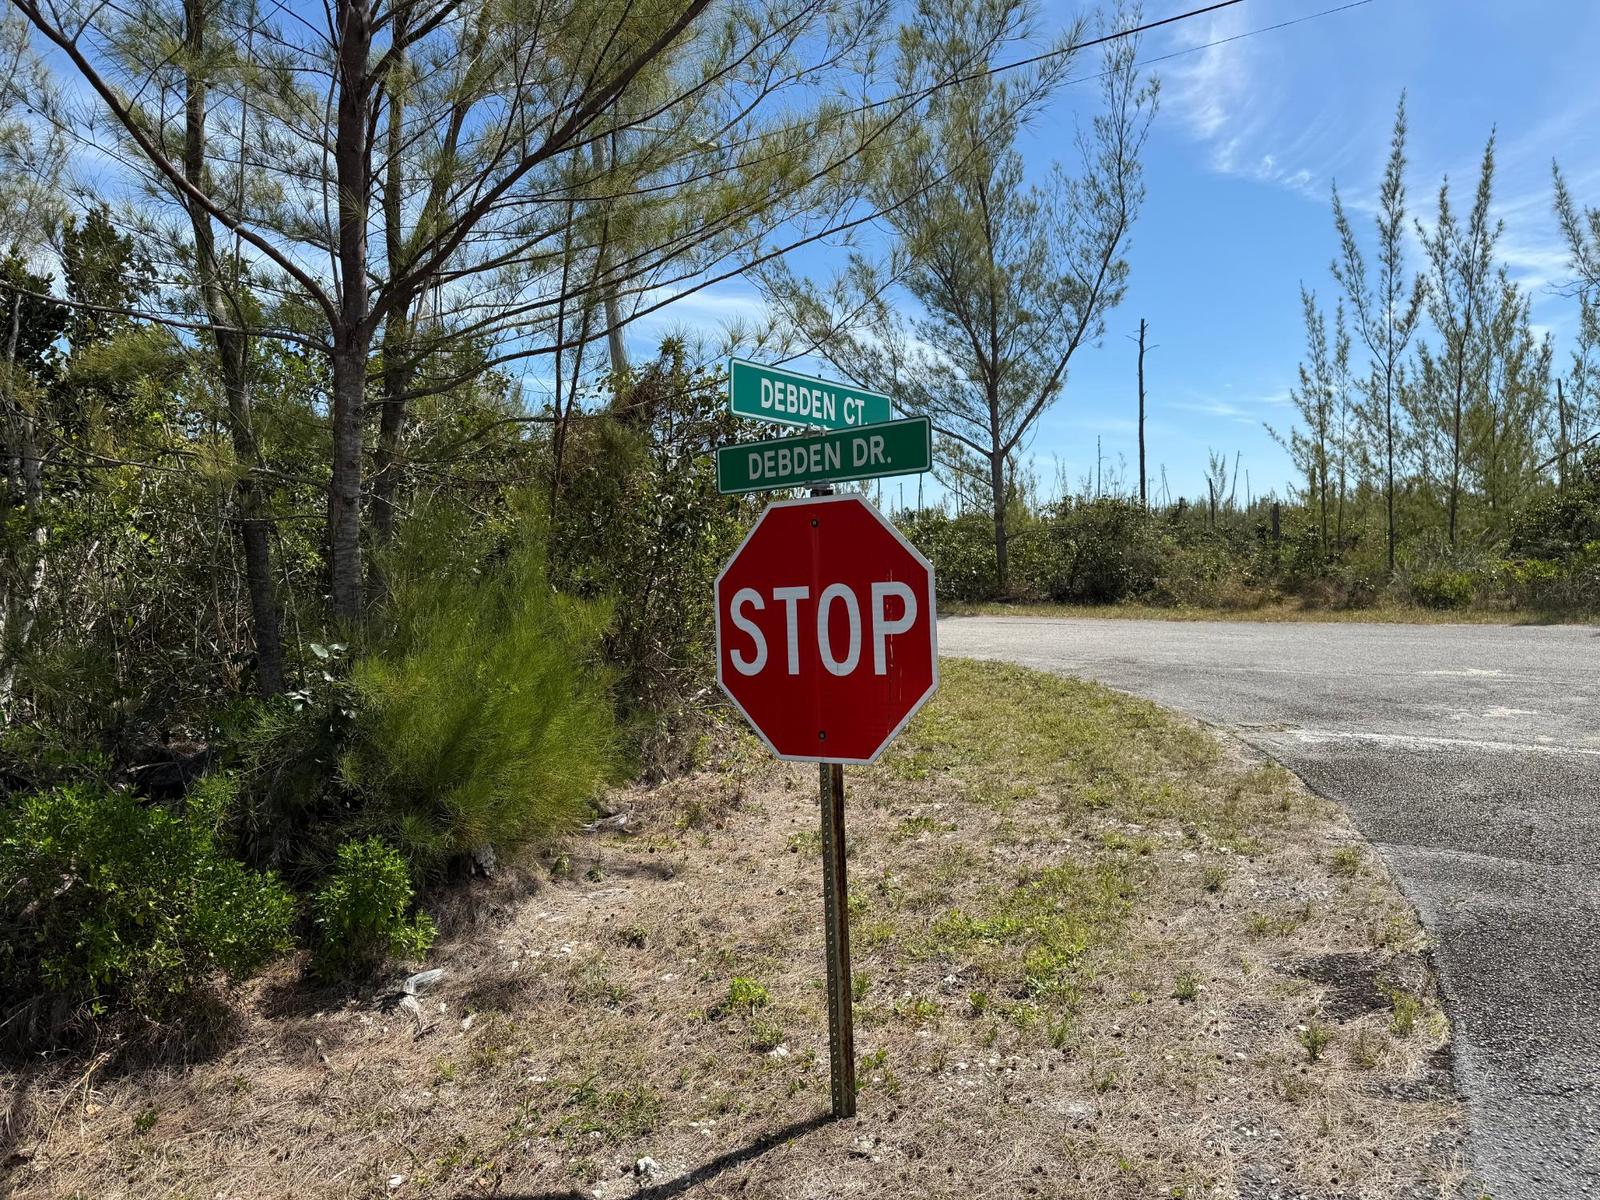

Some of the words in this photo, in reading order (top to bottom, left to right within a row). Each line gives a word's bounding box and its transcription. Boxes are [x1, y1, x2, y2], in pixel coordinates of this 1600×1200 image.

[760, 377, 836, 422] DEBDEN
[843, 396, 869, 426] CT.
[748, 440, 841, 480] DEBDEN
[852, 435, 892, 468] DR.
[729, 581, 918, 677] STOP
